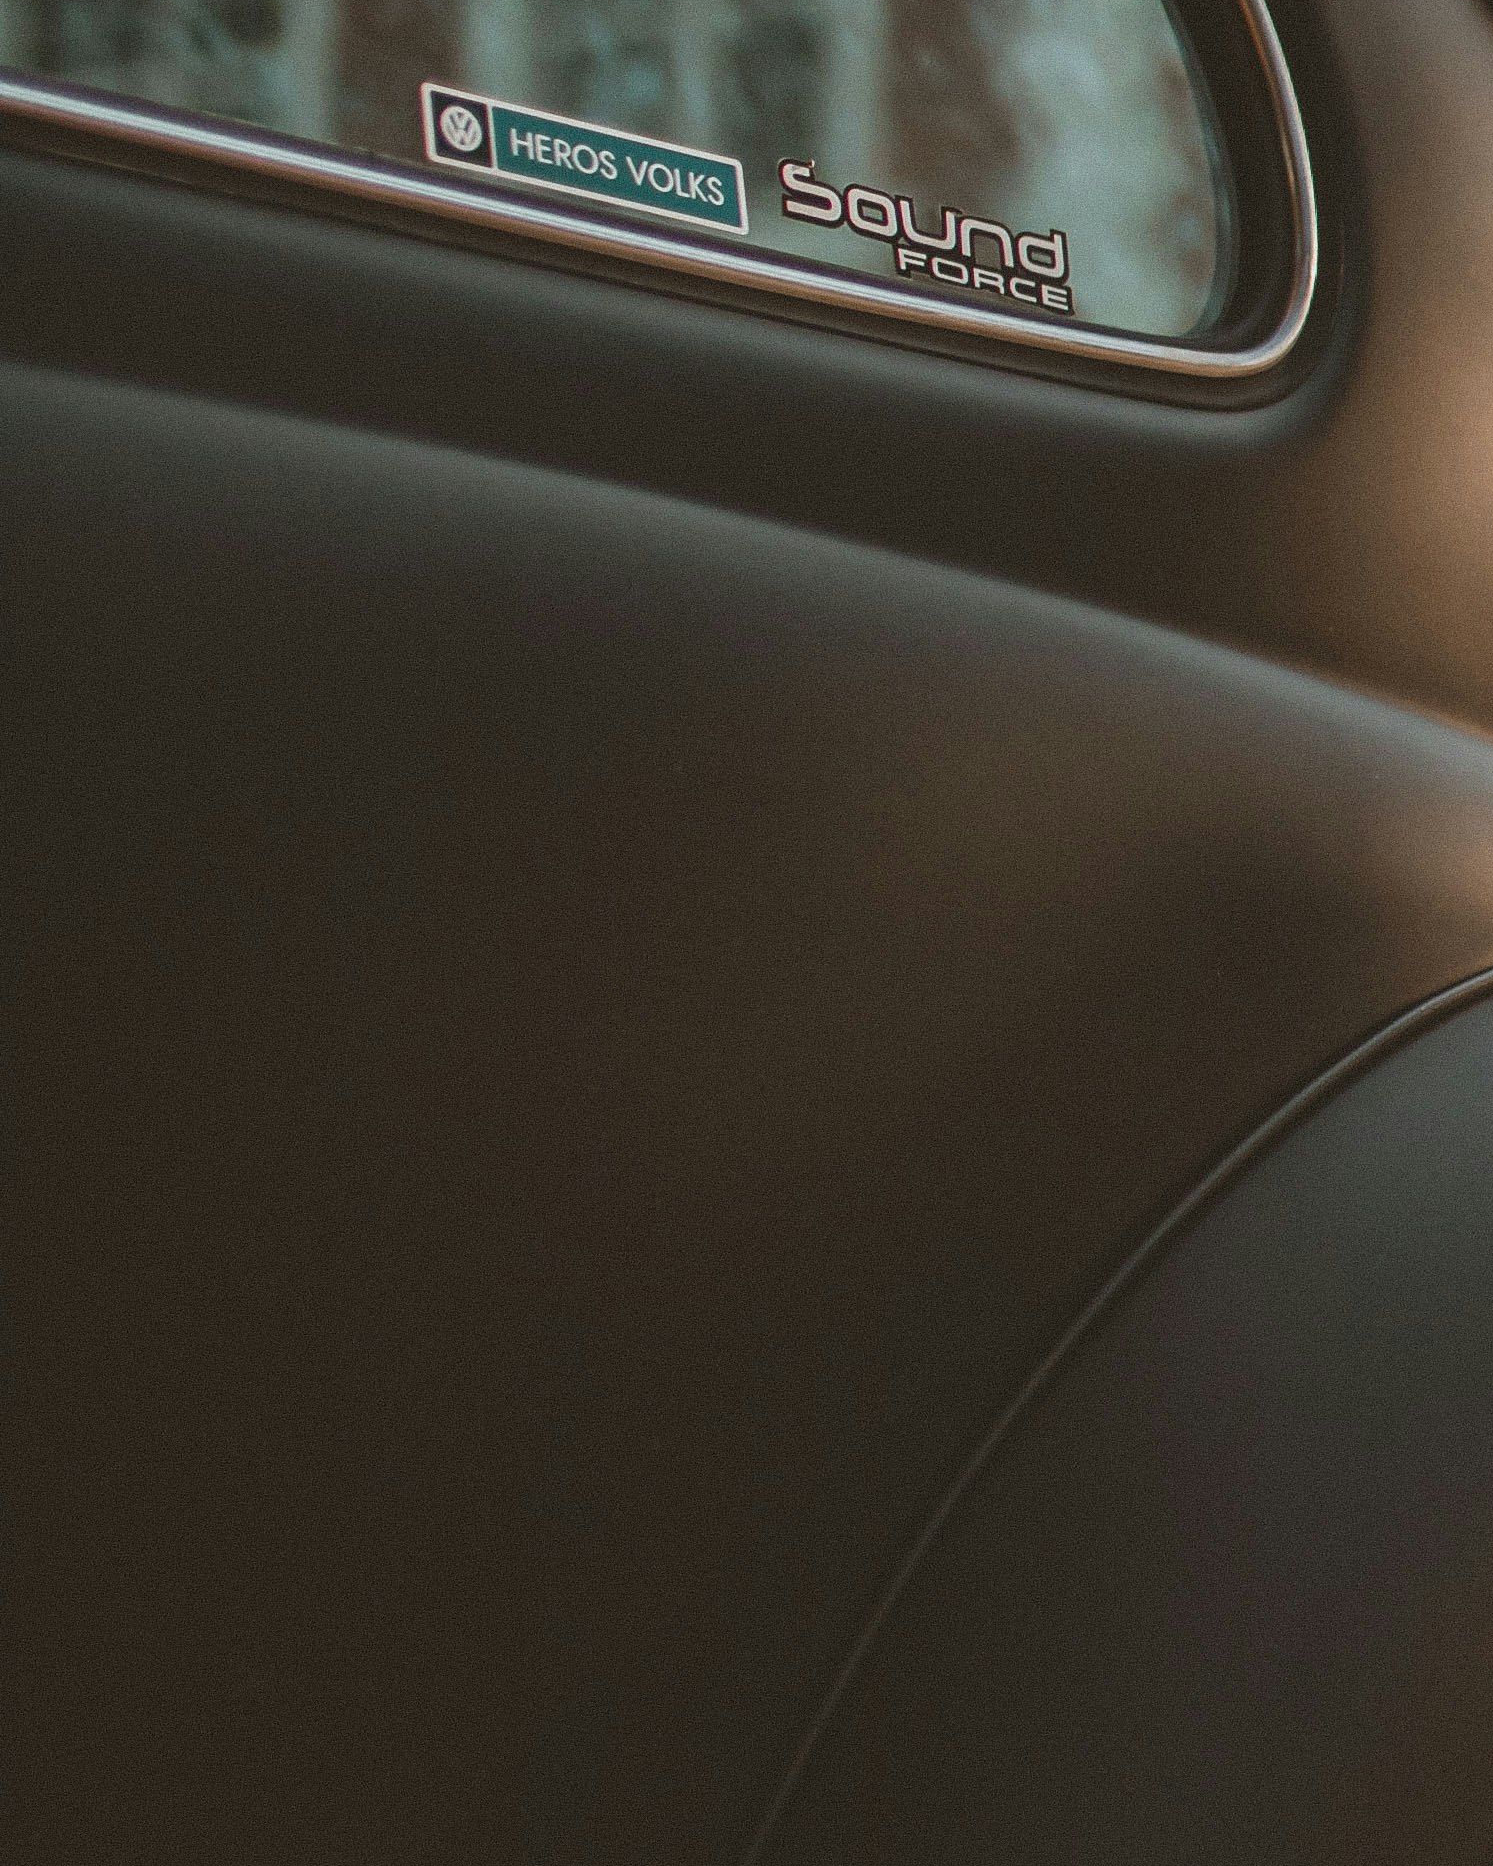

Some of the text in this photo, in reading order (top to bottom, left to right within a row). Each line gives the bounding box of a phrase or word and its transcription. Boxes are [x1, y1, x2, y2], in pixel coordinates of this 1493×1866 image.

[509, 128, 618, 179] HEROS
[626, 155, 724, 206] VOLKS
[898, 247, 1070, 312] FORCE
